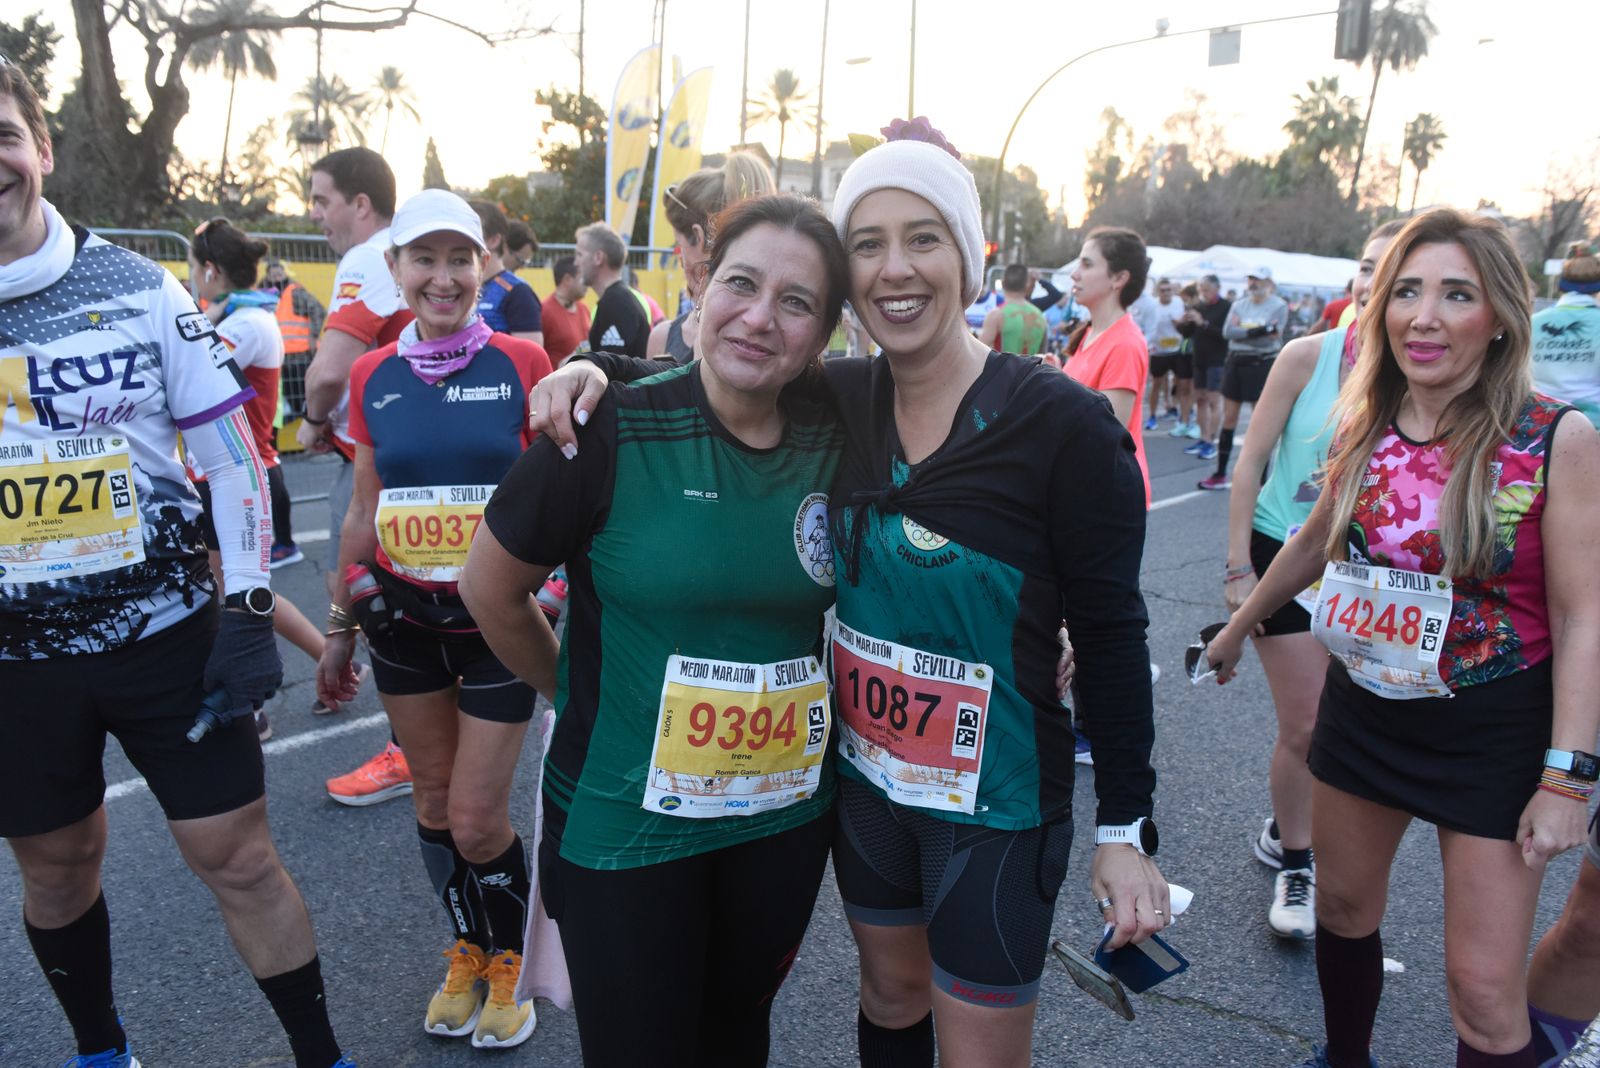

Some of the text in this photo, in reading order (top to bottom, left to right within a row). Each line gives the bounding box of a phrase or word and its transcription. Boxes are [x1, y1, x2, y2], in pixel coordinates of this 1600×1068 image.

[0, 437, 106, 461] ARATÓN SEVILLA
[387, 487, 487, 503] MEDIO MARATÓN SEVILLA
[41, 518, 64, 527] Nieto
[260, 518, 271, 532] DEL
[795, 499, 812, 532] ATLETISMO
[21, 535, 39, 543] Nieto
[386, 514, 484, 547] 10937
[796, 534, 805, 554] CLUB
[47, 562, 72, 572] HOKA
[896, 545, 960, 568] CHICLANA
[1388, 569, 1431, 592] SEVILLA
[1326, 593, 1422, 645] 14248
[838, 623, 966, 681] MEDIO MARATÓN SEVILLA
[680, 661, 809, 686] MEDIO MARATÓN SEVILLA
[848, 667, 942, 737] 1087
[687, 702, 797, 750] 9394
[731, 753, 753, 761] Irene
[724, 800, 750, 808] HOKA
